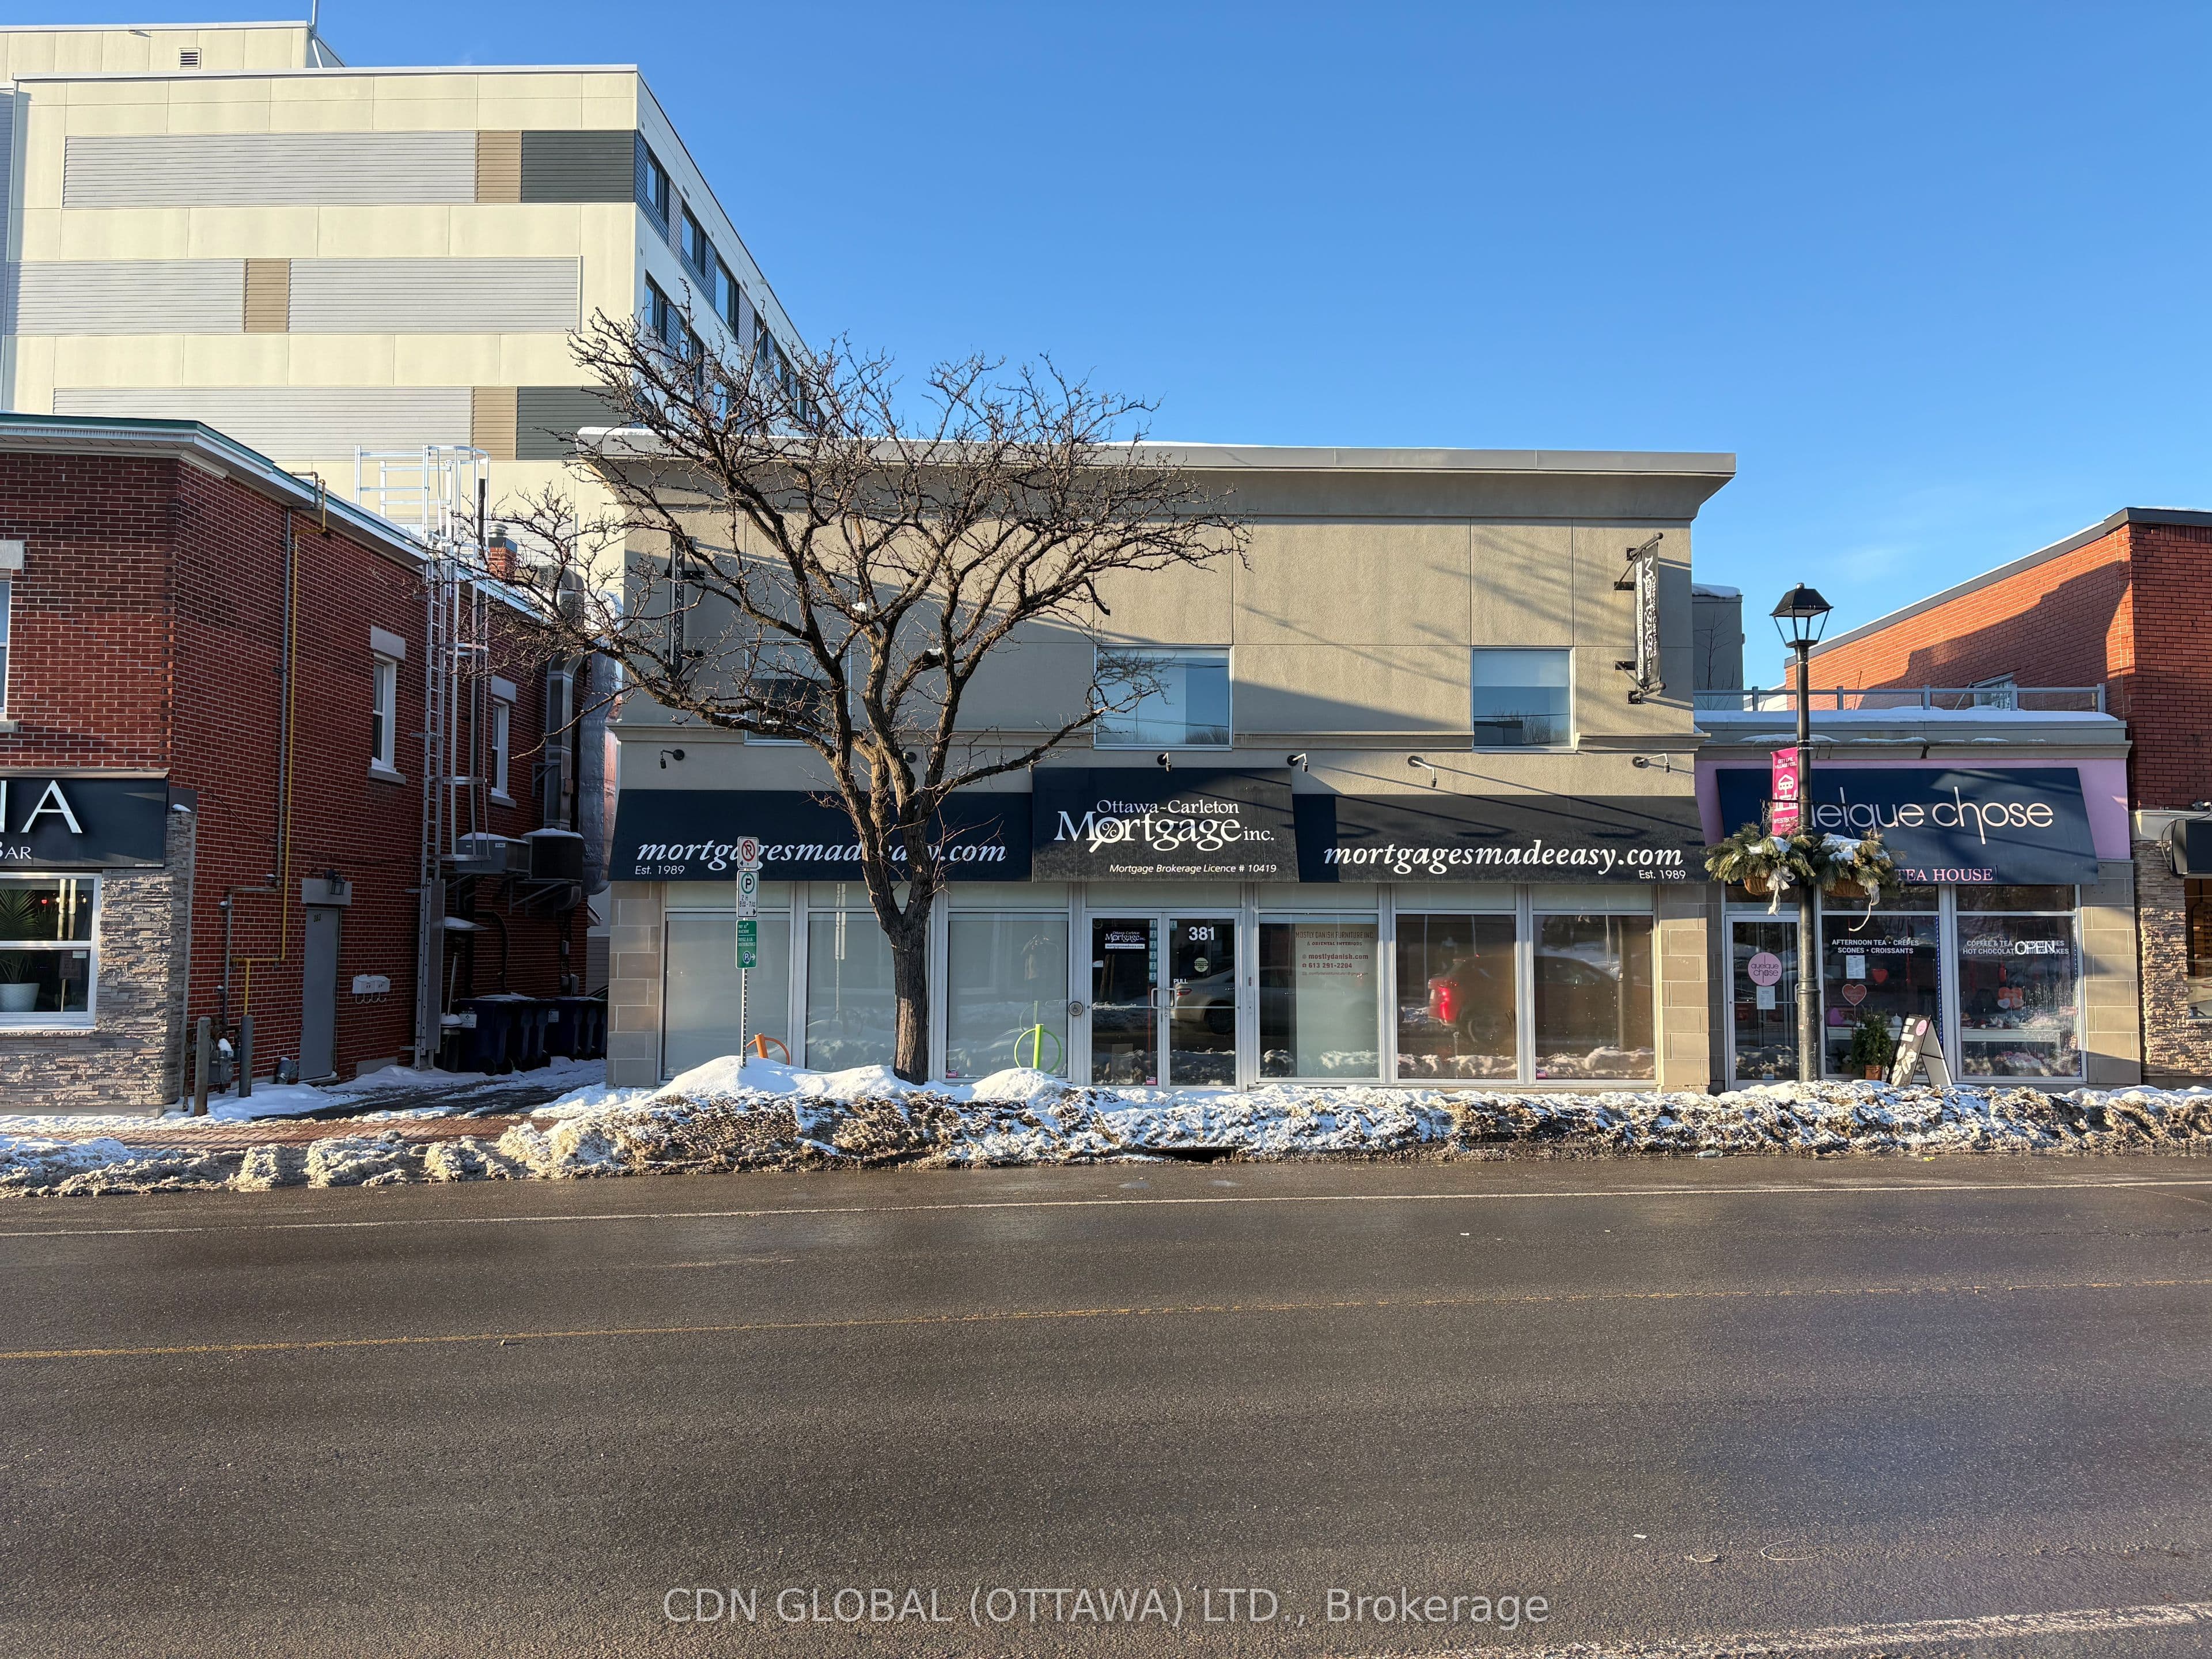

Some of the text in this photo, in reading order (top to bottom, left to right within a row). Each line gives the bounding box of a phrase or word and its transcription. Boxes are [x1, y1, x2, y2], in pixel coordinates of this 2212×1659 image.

[1643, 555, 1654, 659] Mortgage
[1932, 786, 2053, 844] chose
[1054, 811, 1275, 853] Mortgage inc.
[1324, 839, 1683, 874] mortgagesmadeeasy.com
[635, 865, 685, 874] Est. 1989
[1109, 865, 1154, 874] Mortgage
[1156, 865, 1202, 874] Brokerage
[1639, 869, 1686, 879] Est. 1989
[1894, 869, 1993, 881] TEA HOUSE
[1105, 933, 1140, 942] Mortgage
[1189, 926, 1214, 941] 381
[2015, 941, 2055, 955] OPEN
[1751, 955, 1779, 969] quelque
[1753, 969, 1779, 983] chose
